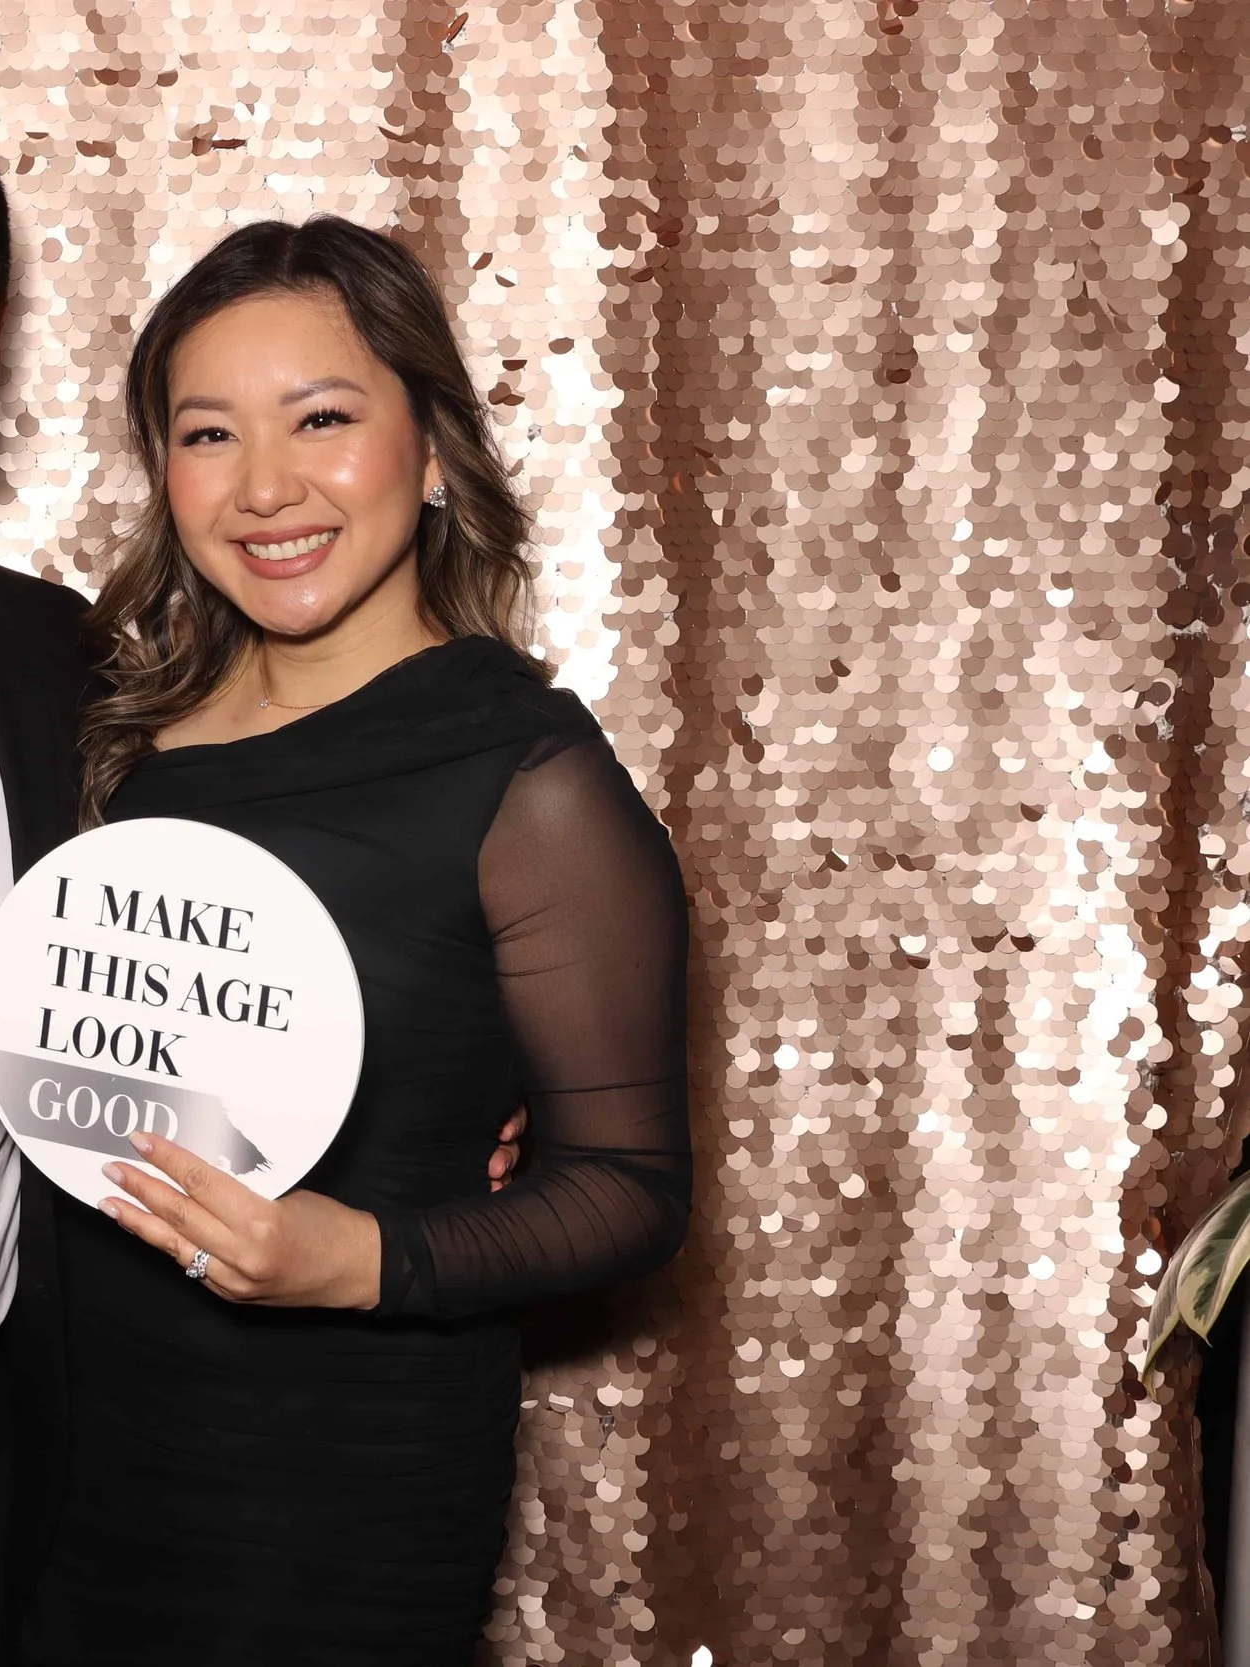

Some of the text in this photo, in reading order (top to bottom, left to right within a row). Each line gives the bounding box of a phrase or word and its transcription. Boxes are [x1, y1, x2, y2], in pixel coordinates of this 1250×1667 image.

[52, 876, 253, 953] I MAKE
[47, 944, 293, 1032] THIS AGE
[36, 1007, 187, 1078] LOOK
[29, 1078, 178, 1142] GOOD
